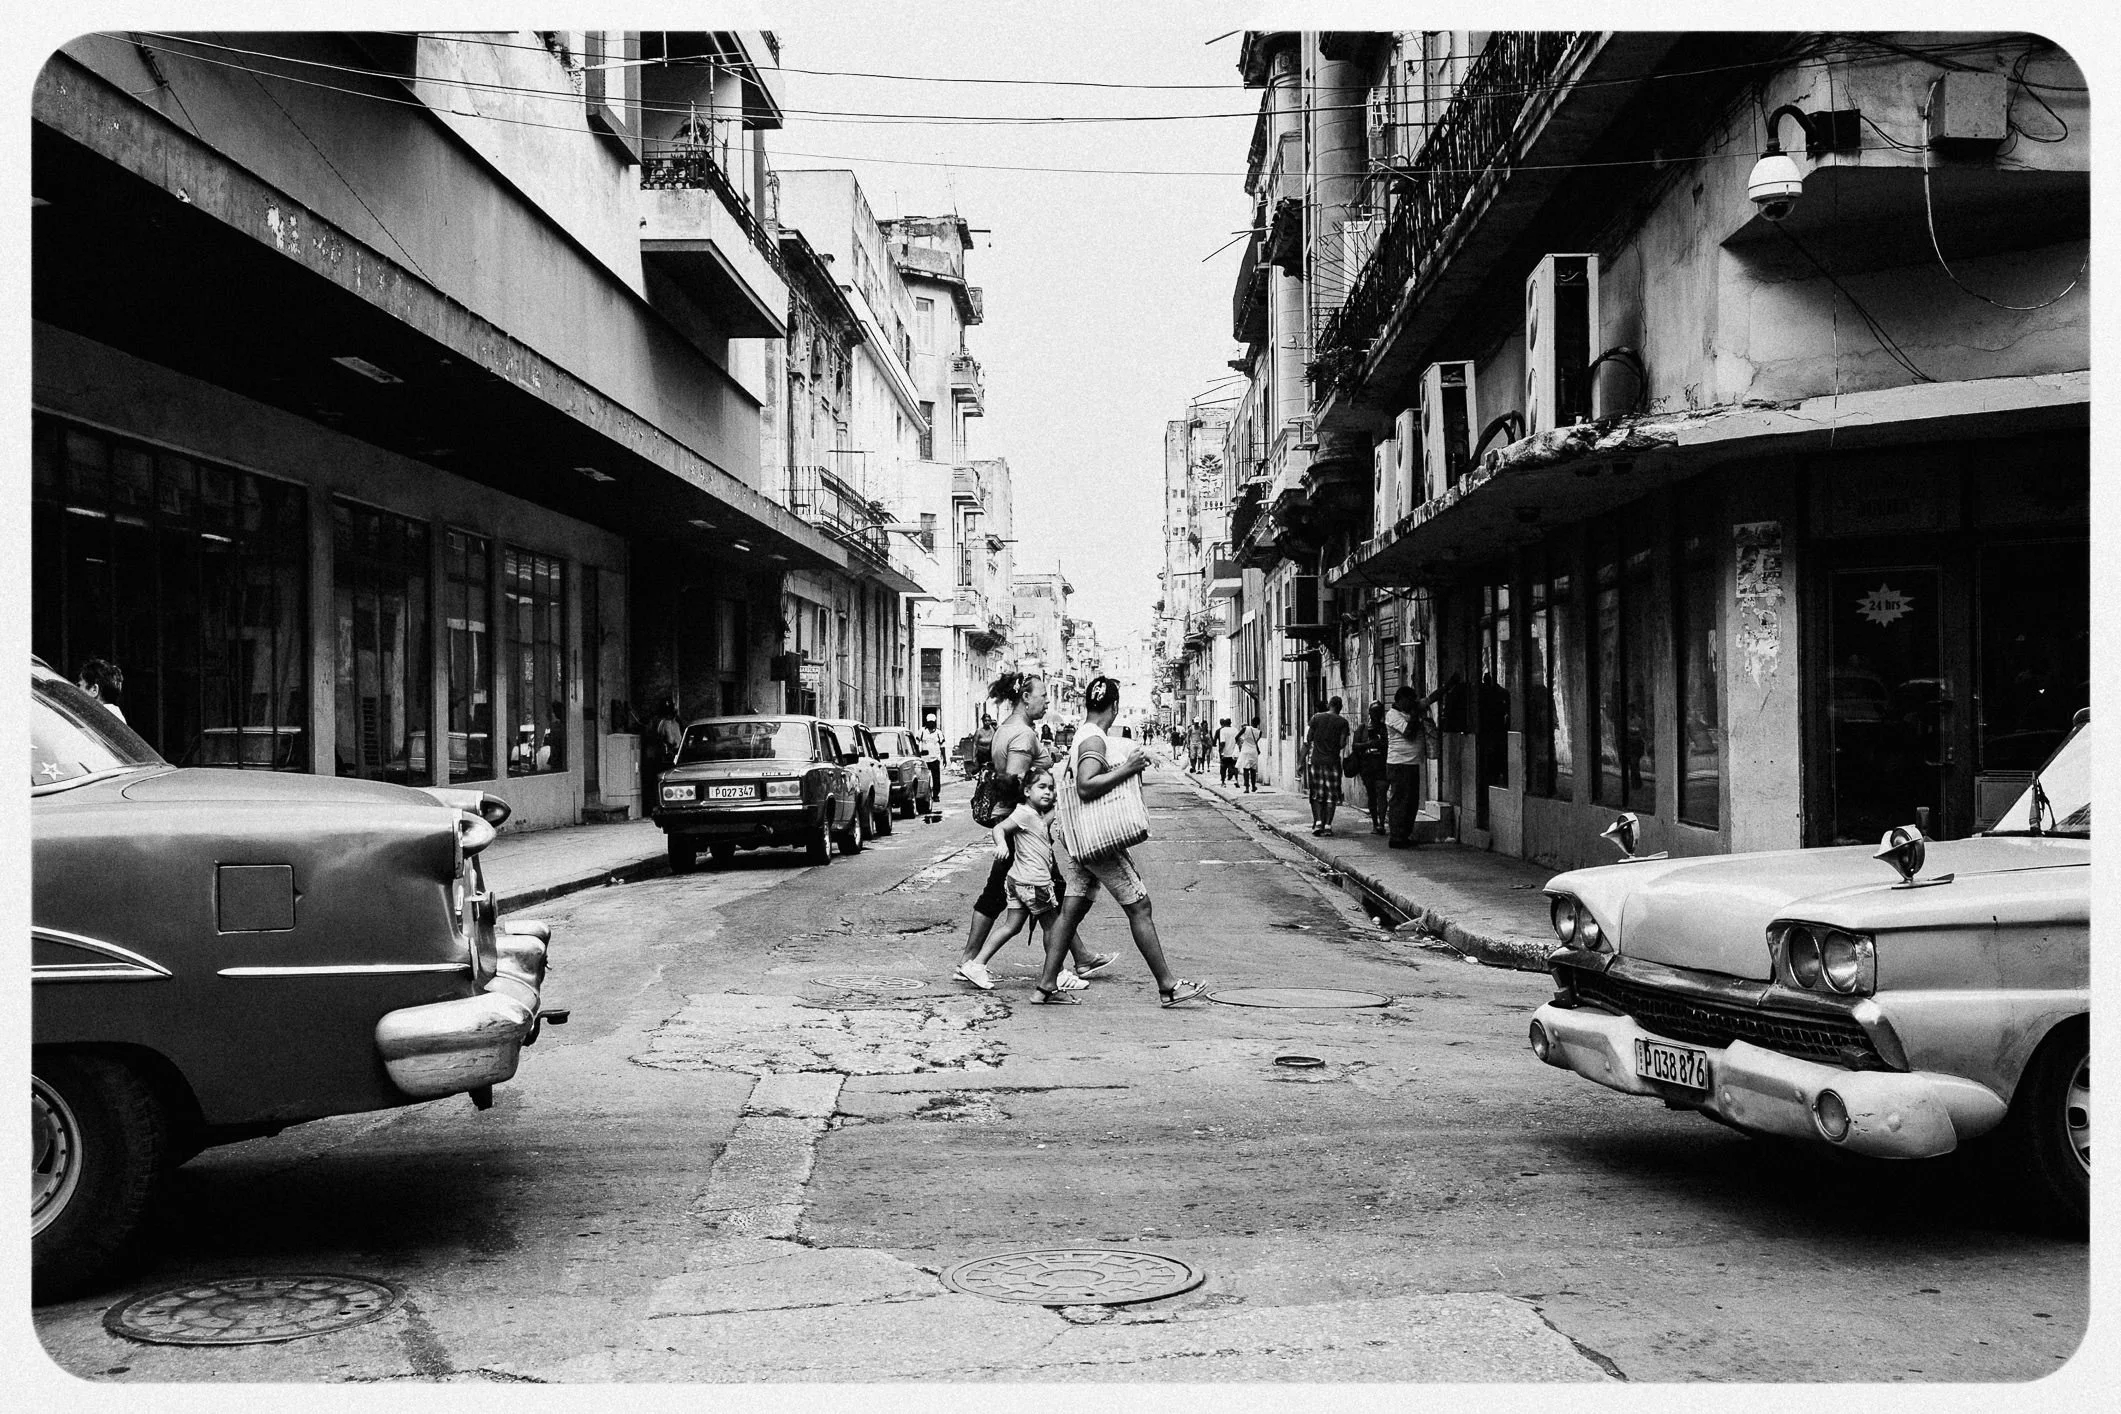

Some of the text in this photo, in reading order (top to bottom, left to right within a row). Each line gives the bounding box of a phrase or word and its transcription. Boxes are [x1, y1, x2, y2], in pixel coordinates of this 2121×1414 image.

[1868, 600, 1901, 611] 24 hrs
[721, 787, 737, 798] 027
[738, 786, 753, 797] 347
[1654, 1049, 1677, 1081] 038
[1680, 1052, 1704, 1087] 876
